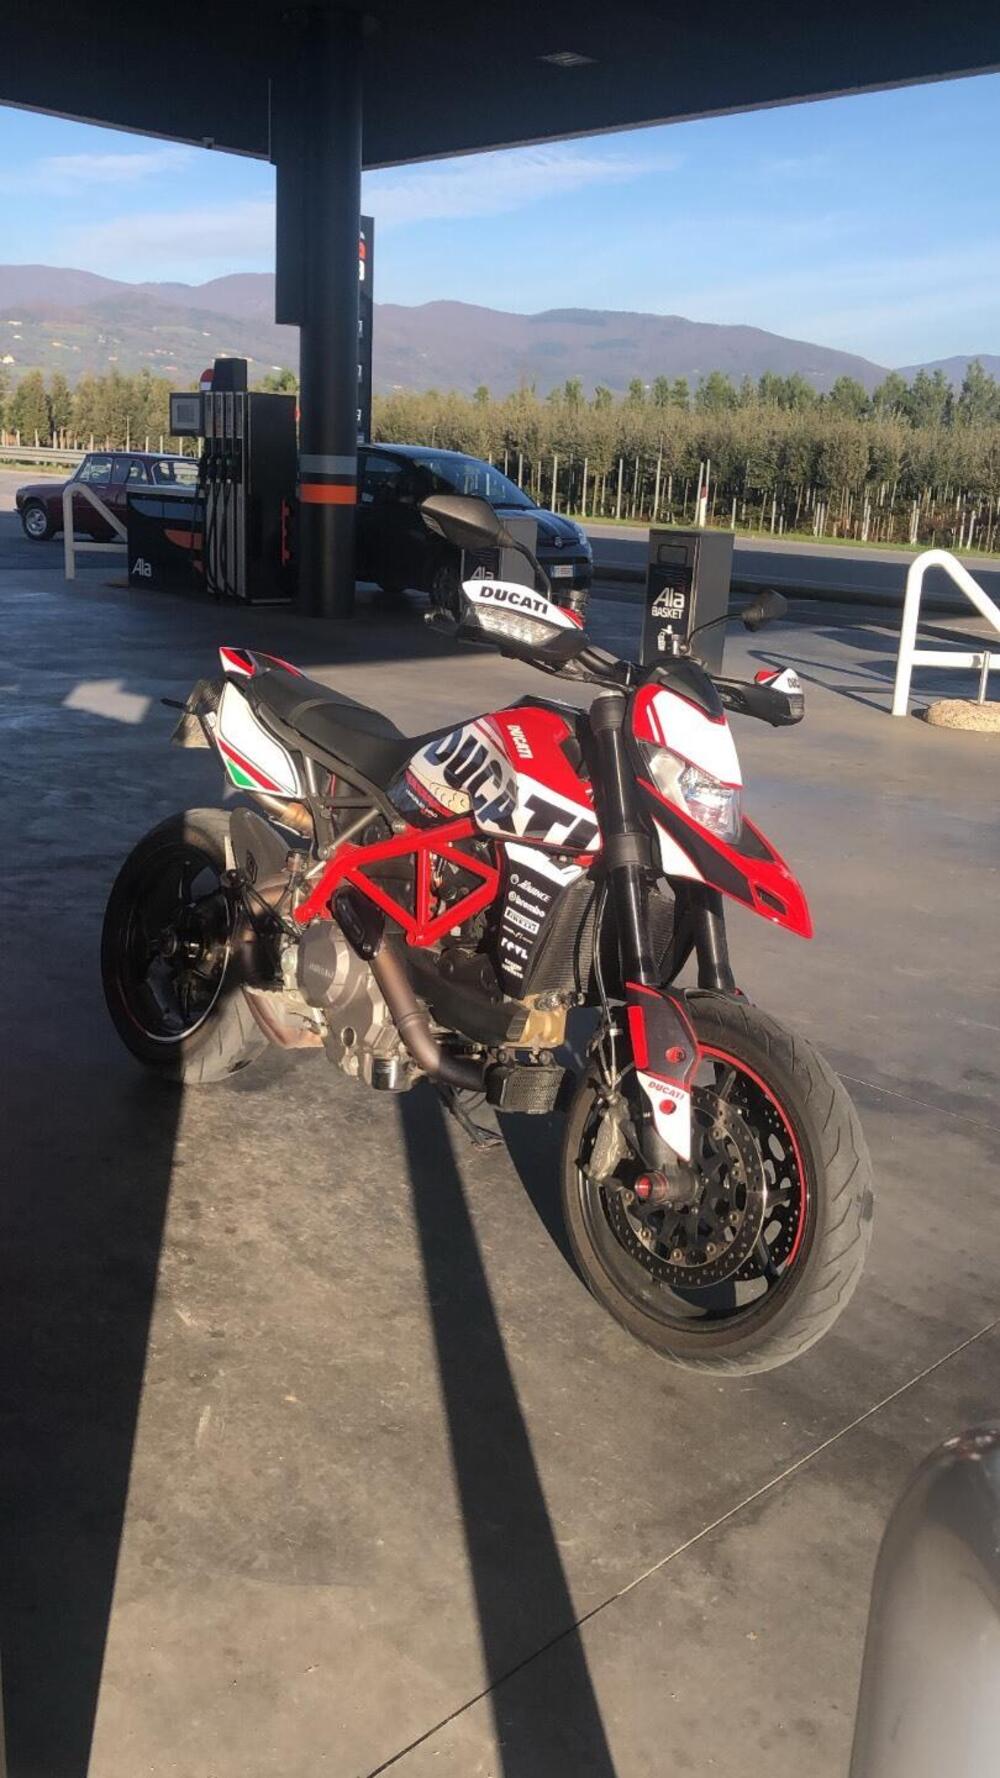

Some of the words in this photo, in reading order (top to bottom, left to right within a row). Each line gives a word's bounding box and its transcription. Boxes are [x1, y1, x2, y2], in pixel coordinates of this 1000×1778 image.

[480, 586, 547, 615] DUCATI
[653, 587, 685, 608] Ala
[651, 606, 684, 619] BASKET
[506, 724, 534, 759] DUCATI
[648, 1081, 685, 1100] DUCATI
